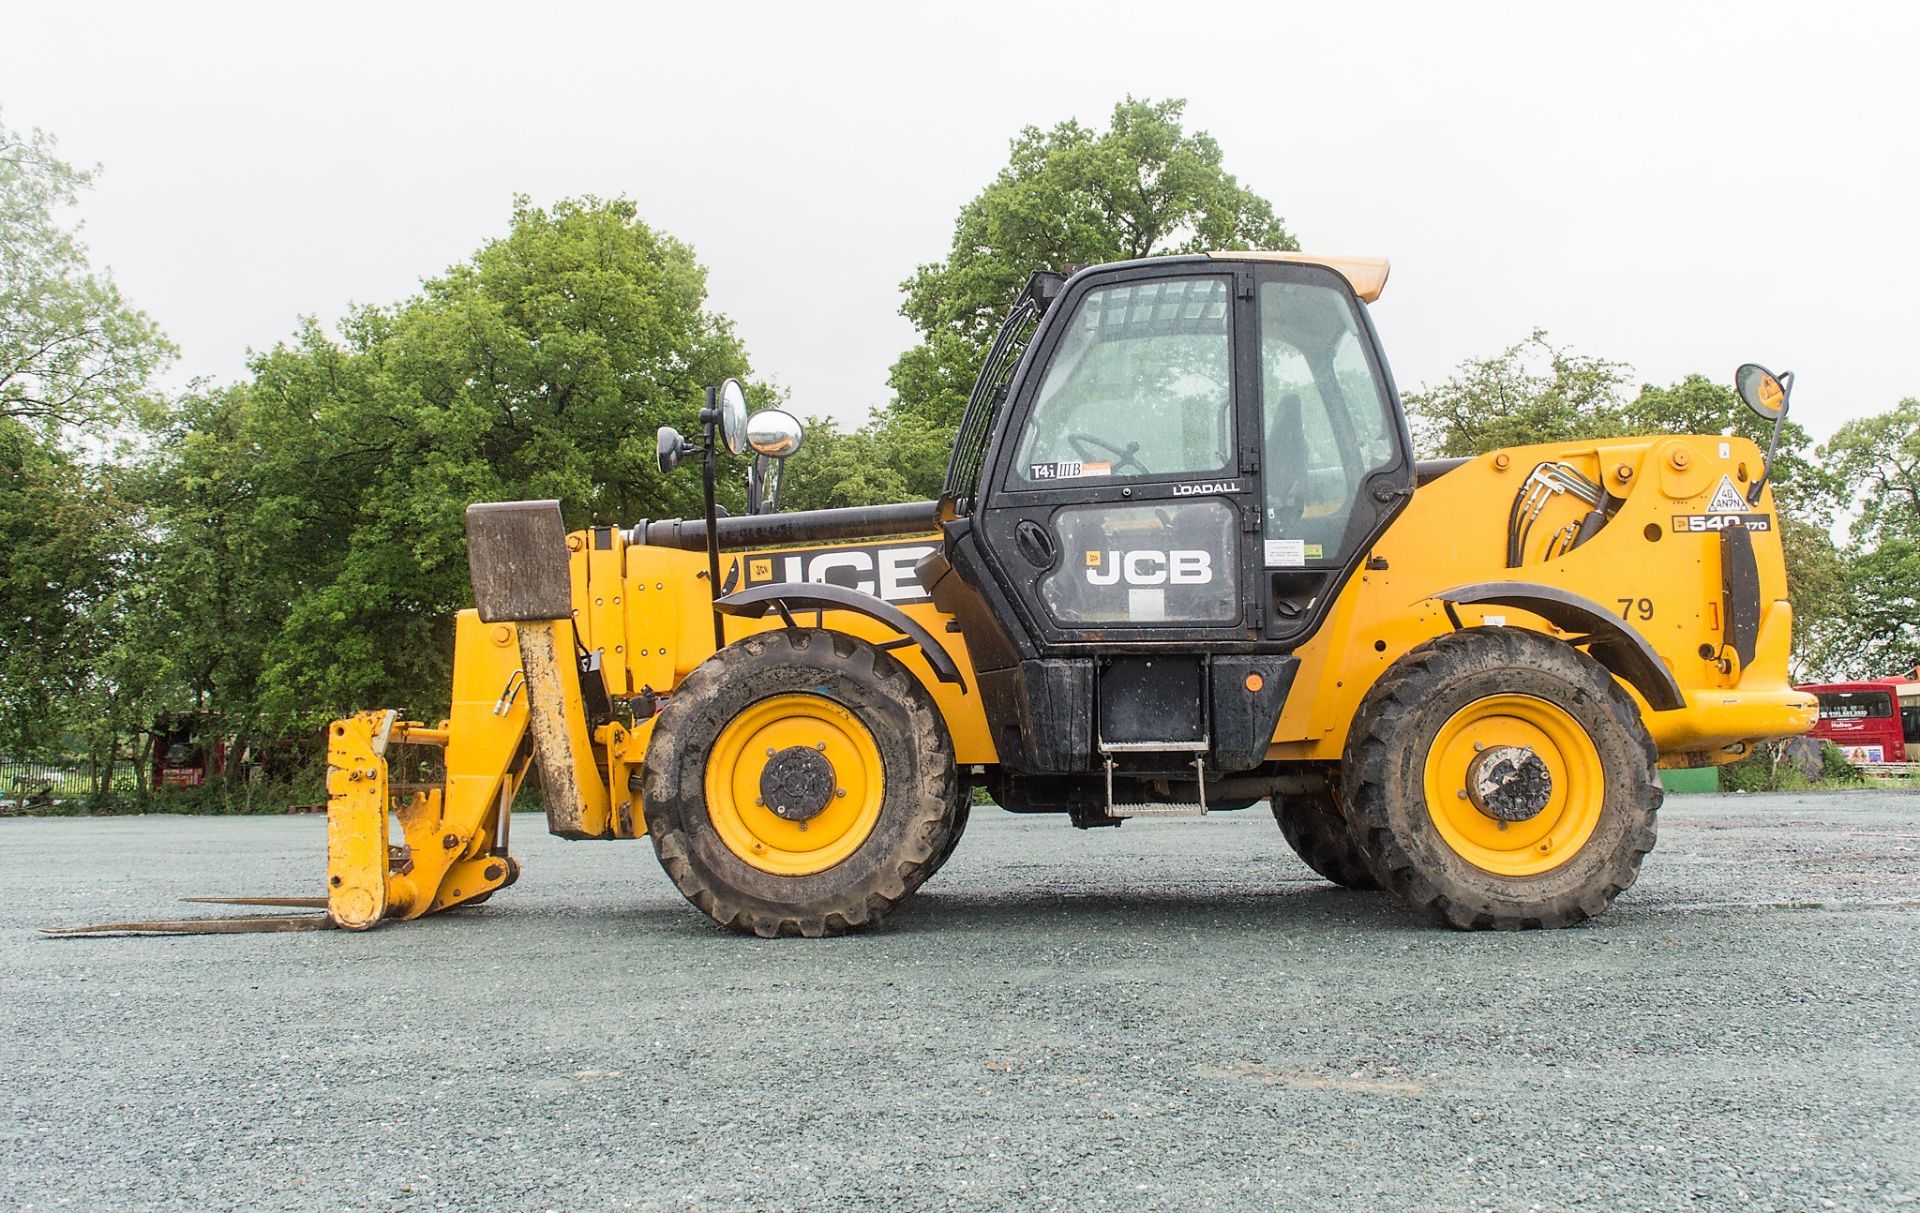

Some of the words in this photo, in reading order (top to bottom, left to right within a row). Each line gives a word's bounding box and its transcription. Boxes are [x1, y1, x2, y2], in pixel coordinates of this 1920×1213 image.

[1031, 464, 1056, 479] T4i
[1173, 482, 1240, 496] LOADALL
[1744, 521, 1768, 531] 170
[1086, 550, 1213, 585] JCB
[1617, 598, 1654, 621] 79
